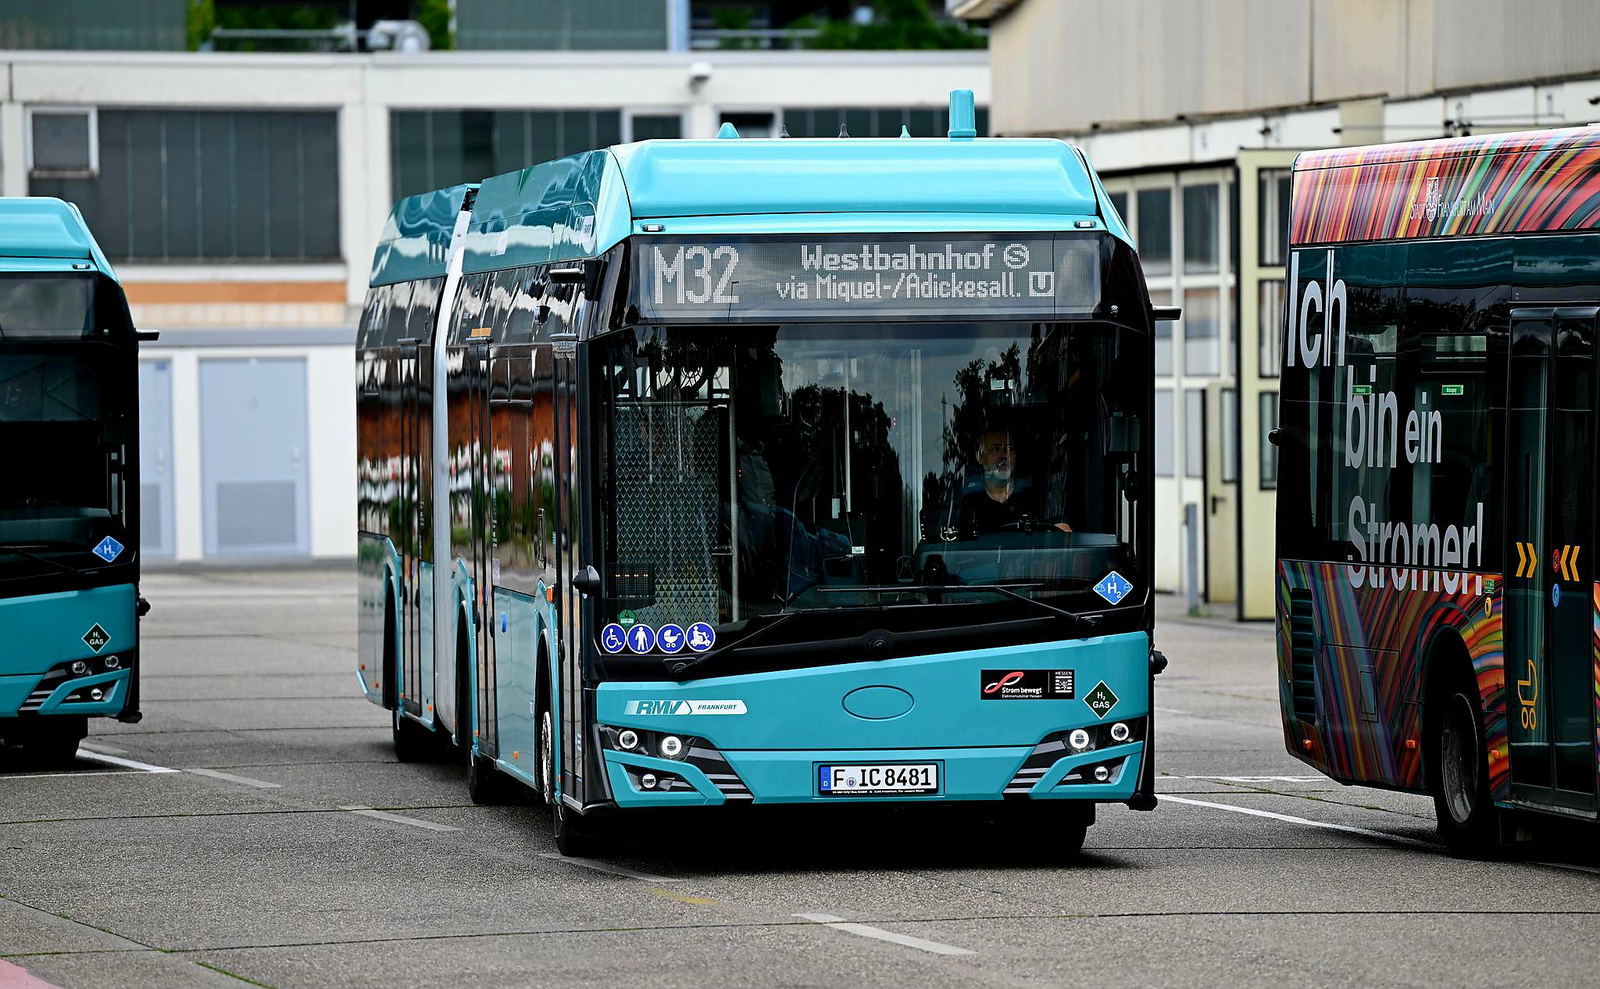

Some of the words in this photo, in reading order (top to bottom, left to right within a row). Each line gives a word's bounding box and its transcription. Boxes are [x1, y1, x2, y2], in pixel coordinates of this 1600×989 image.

[800, 244, 996, 272] Westbahnhof
[654, 245, 740, 305] M32
[776, 274, 809, 300] via
[815, 272, 1021, 302] Miquel-/Adickesall.
[1287, 249, 1347, 369] Ich
[1345, 364, 1398, 469] bin
[1405, 391, 1442, 464] ein
[1347, 495, 1484, 596] Stromer!
[1021, 687, 1042, 695] bewegt
[1092, 701, 1110, 709] GAS
[636, 700, 684, 715] RMV
[833, 769, 846, 787] F
[859, 768, 881, 787] IC
[885, 768, 932, 787] 8481
